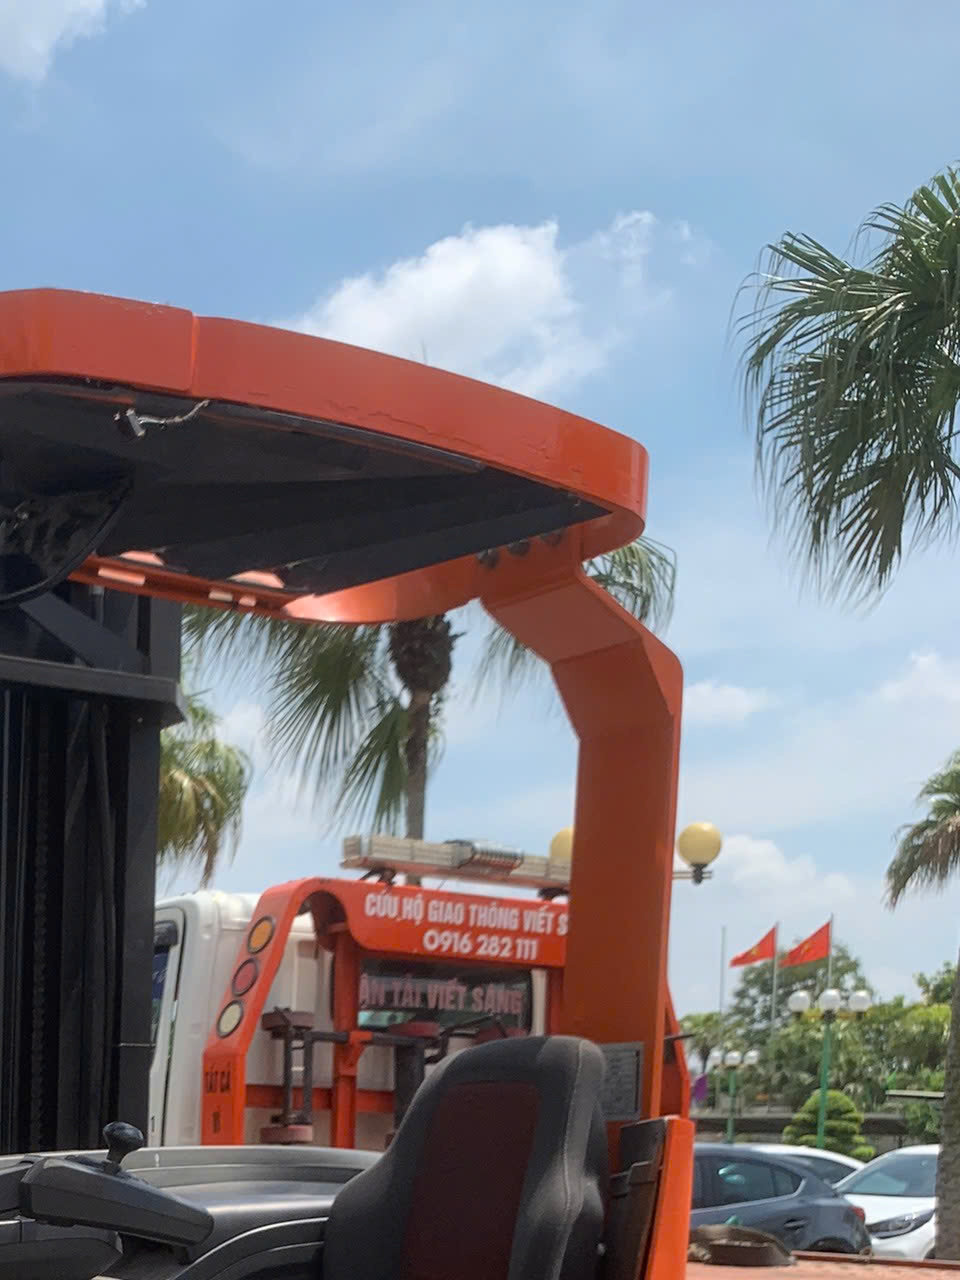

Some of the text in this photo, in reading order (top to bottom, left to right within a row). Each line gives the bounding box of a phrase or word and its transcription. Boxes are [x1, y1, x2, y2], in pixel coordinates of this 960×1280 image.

[402, 894, 424, 925] HỘ
[428, 899, 464, 925] GIAO
[469, 902, 519, 930] THÔNG
[423, 929, 539, 960] 0916 282 111
